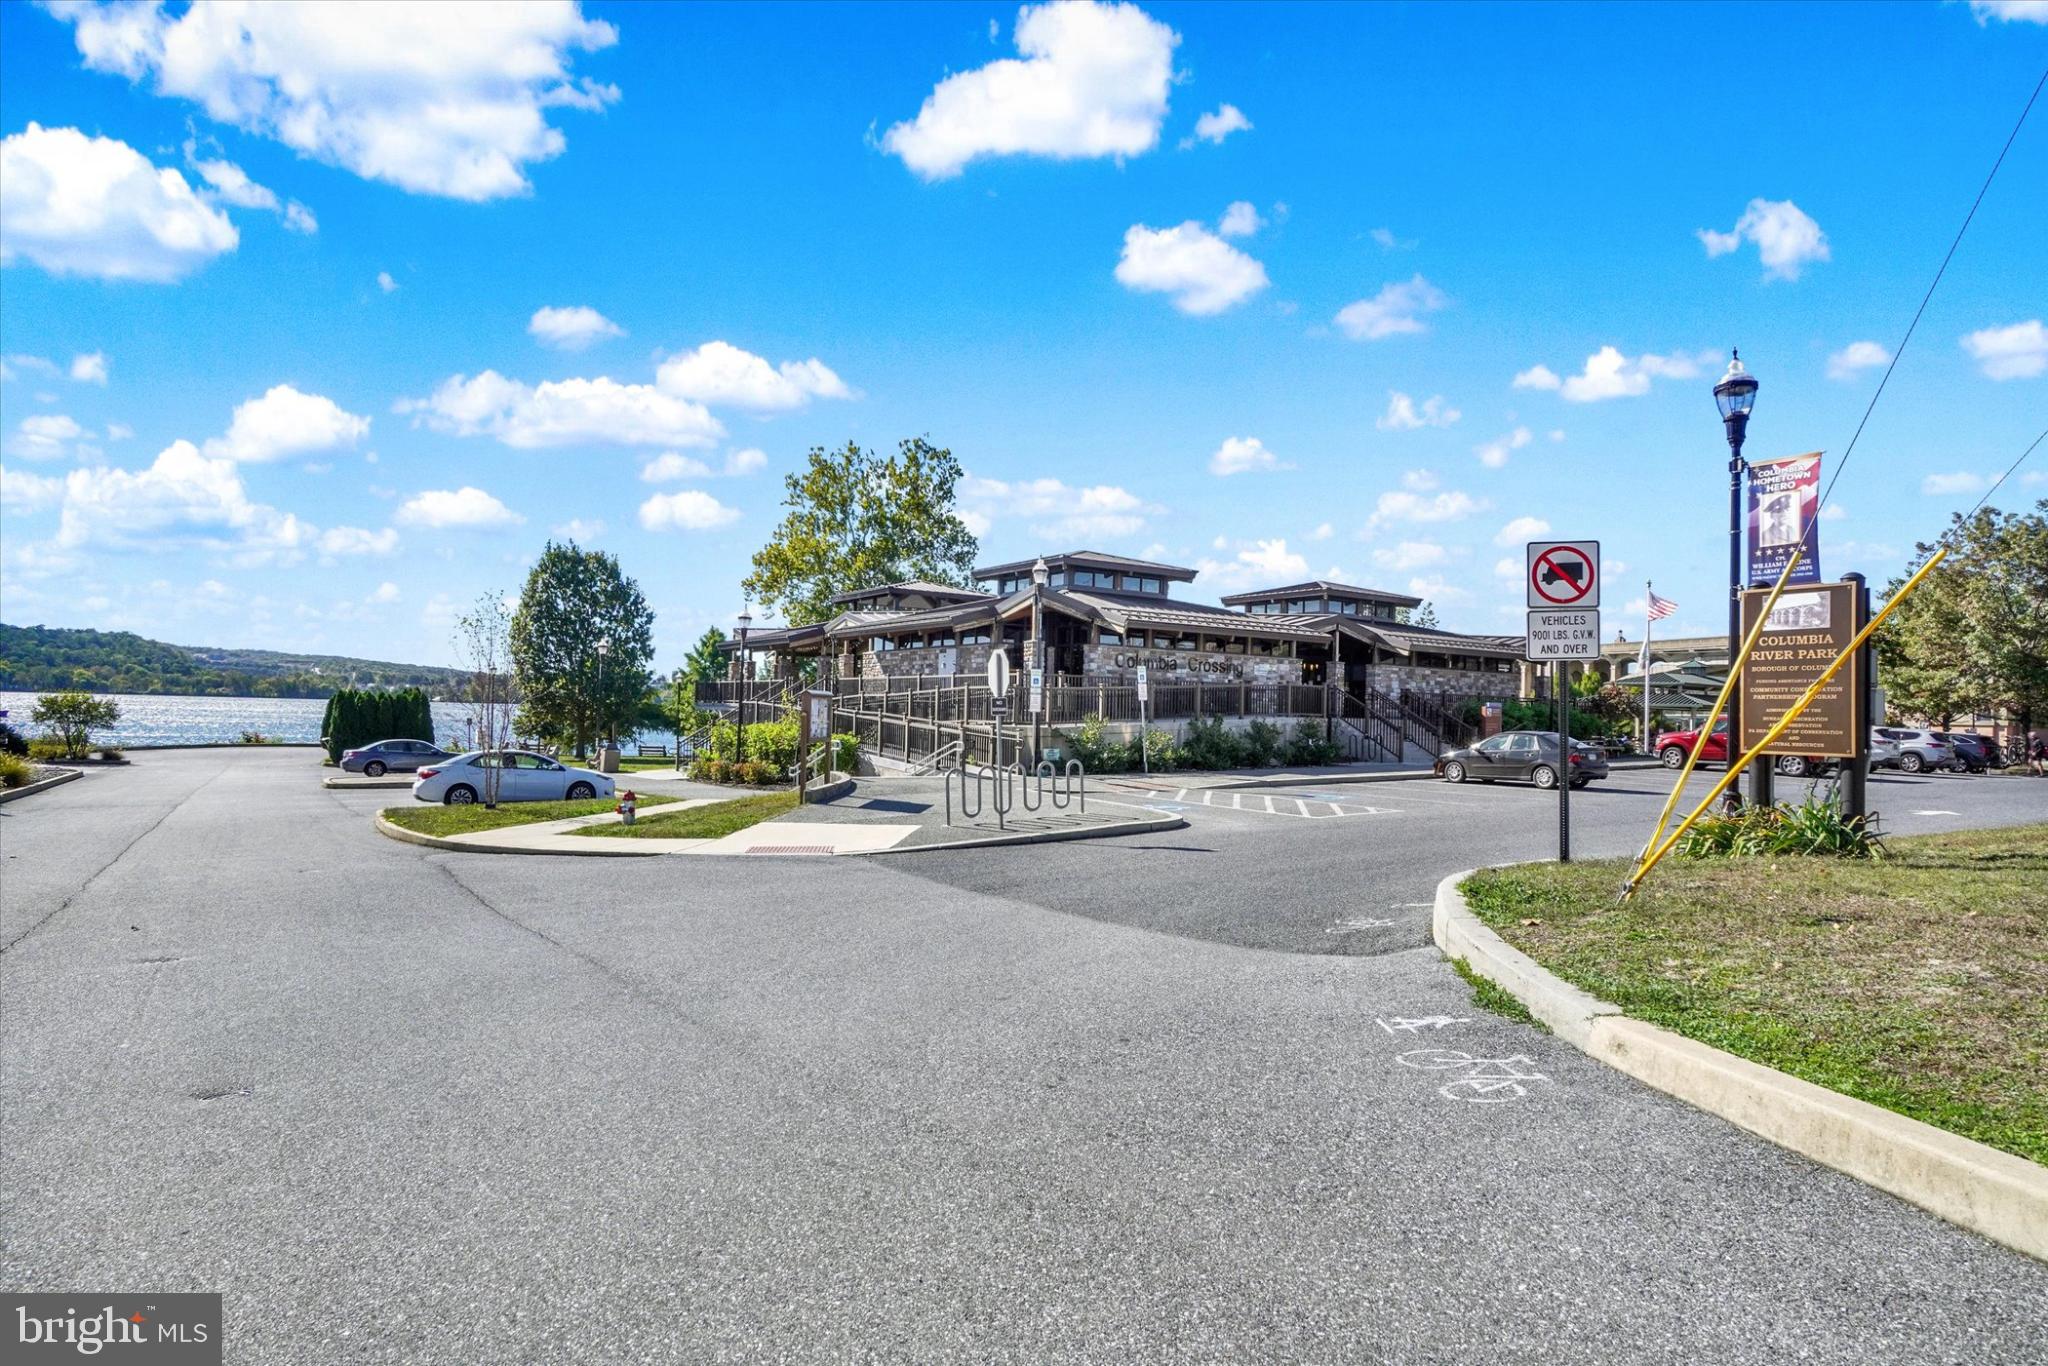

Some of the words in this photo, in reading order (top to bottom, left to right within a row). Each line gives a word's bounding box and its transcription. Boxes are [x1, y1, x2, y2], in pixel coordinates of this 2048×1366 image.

[1753, 471, 1811, 486] HOMETOWN
[1766, 481, 1796, 492] HERO
[1752, 561, 1782, 569] WILLIAM
[1541, 615, 1586, 625] VEHICLES
[1532, 630, 1551, 640] 9001
[1553, 630, 1570, 640] LBS.
[1572, 629, 1596, 640] G.V.W.
[1759, 634, 1834, 647] COLUMBIA
[1540, 644, 1559, 654] AND
[1563, 643, 1588, 654] OVER
[1751, 651, 1794, 661] RIVER
[1799, 649, 1839, 660] PARK
[1114, 652, 1178, 671] Columbia
[1187, 655, 1244, 678] Crossing
